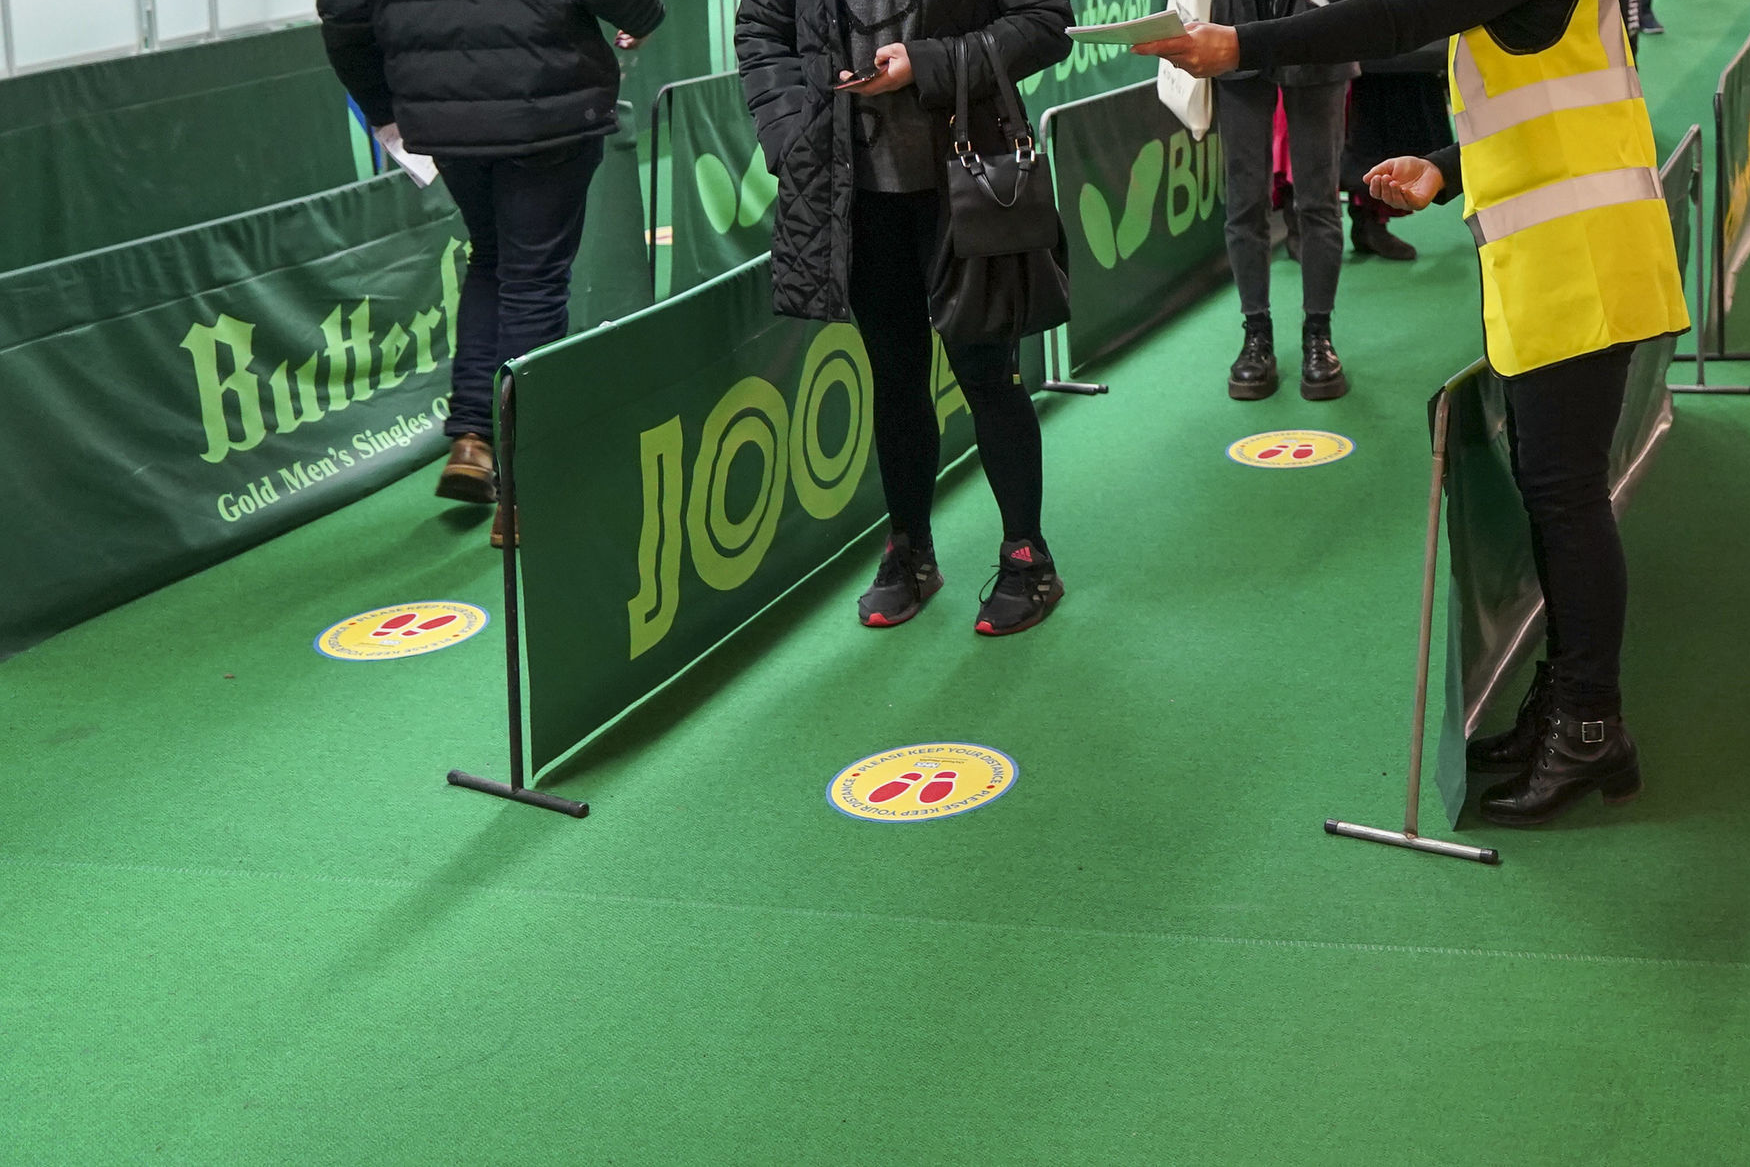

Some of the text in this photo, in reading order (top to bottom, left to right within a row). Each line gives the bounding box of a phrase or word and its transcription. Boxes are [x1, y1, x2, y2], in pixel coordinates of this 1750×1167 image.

[179, 236, 473, 464] Butterf
[216, 392, 453, 523] Gold Men's Singles O
[840, 777, 991, 817] PLEASE KEEP YOUR DISTANCE
[858, 747, 1005, 784] PLEASE KEEP YOUR DISTANCE
